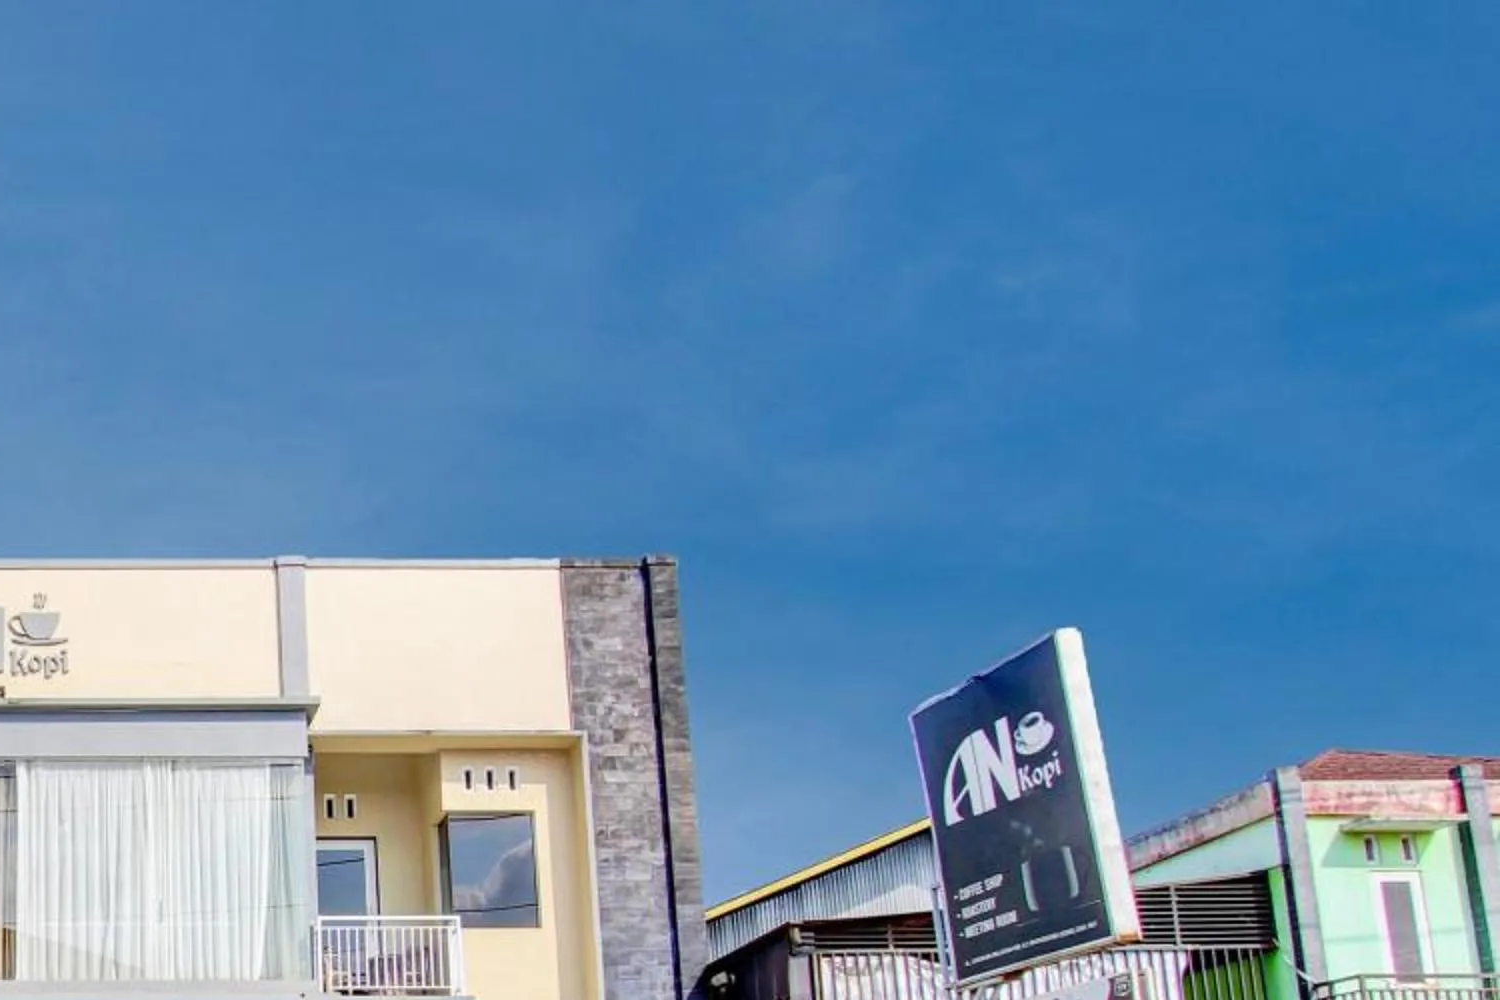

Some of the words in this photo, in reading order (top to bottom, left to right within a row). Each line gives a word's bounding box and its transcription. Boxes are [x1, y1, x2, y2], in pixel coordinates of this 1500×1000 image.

[9, 650, 69, 679] Kopi
[944, 716, 1021, 827] AN
[1018, 750, 1062, 792] Kopi
